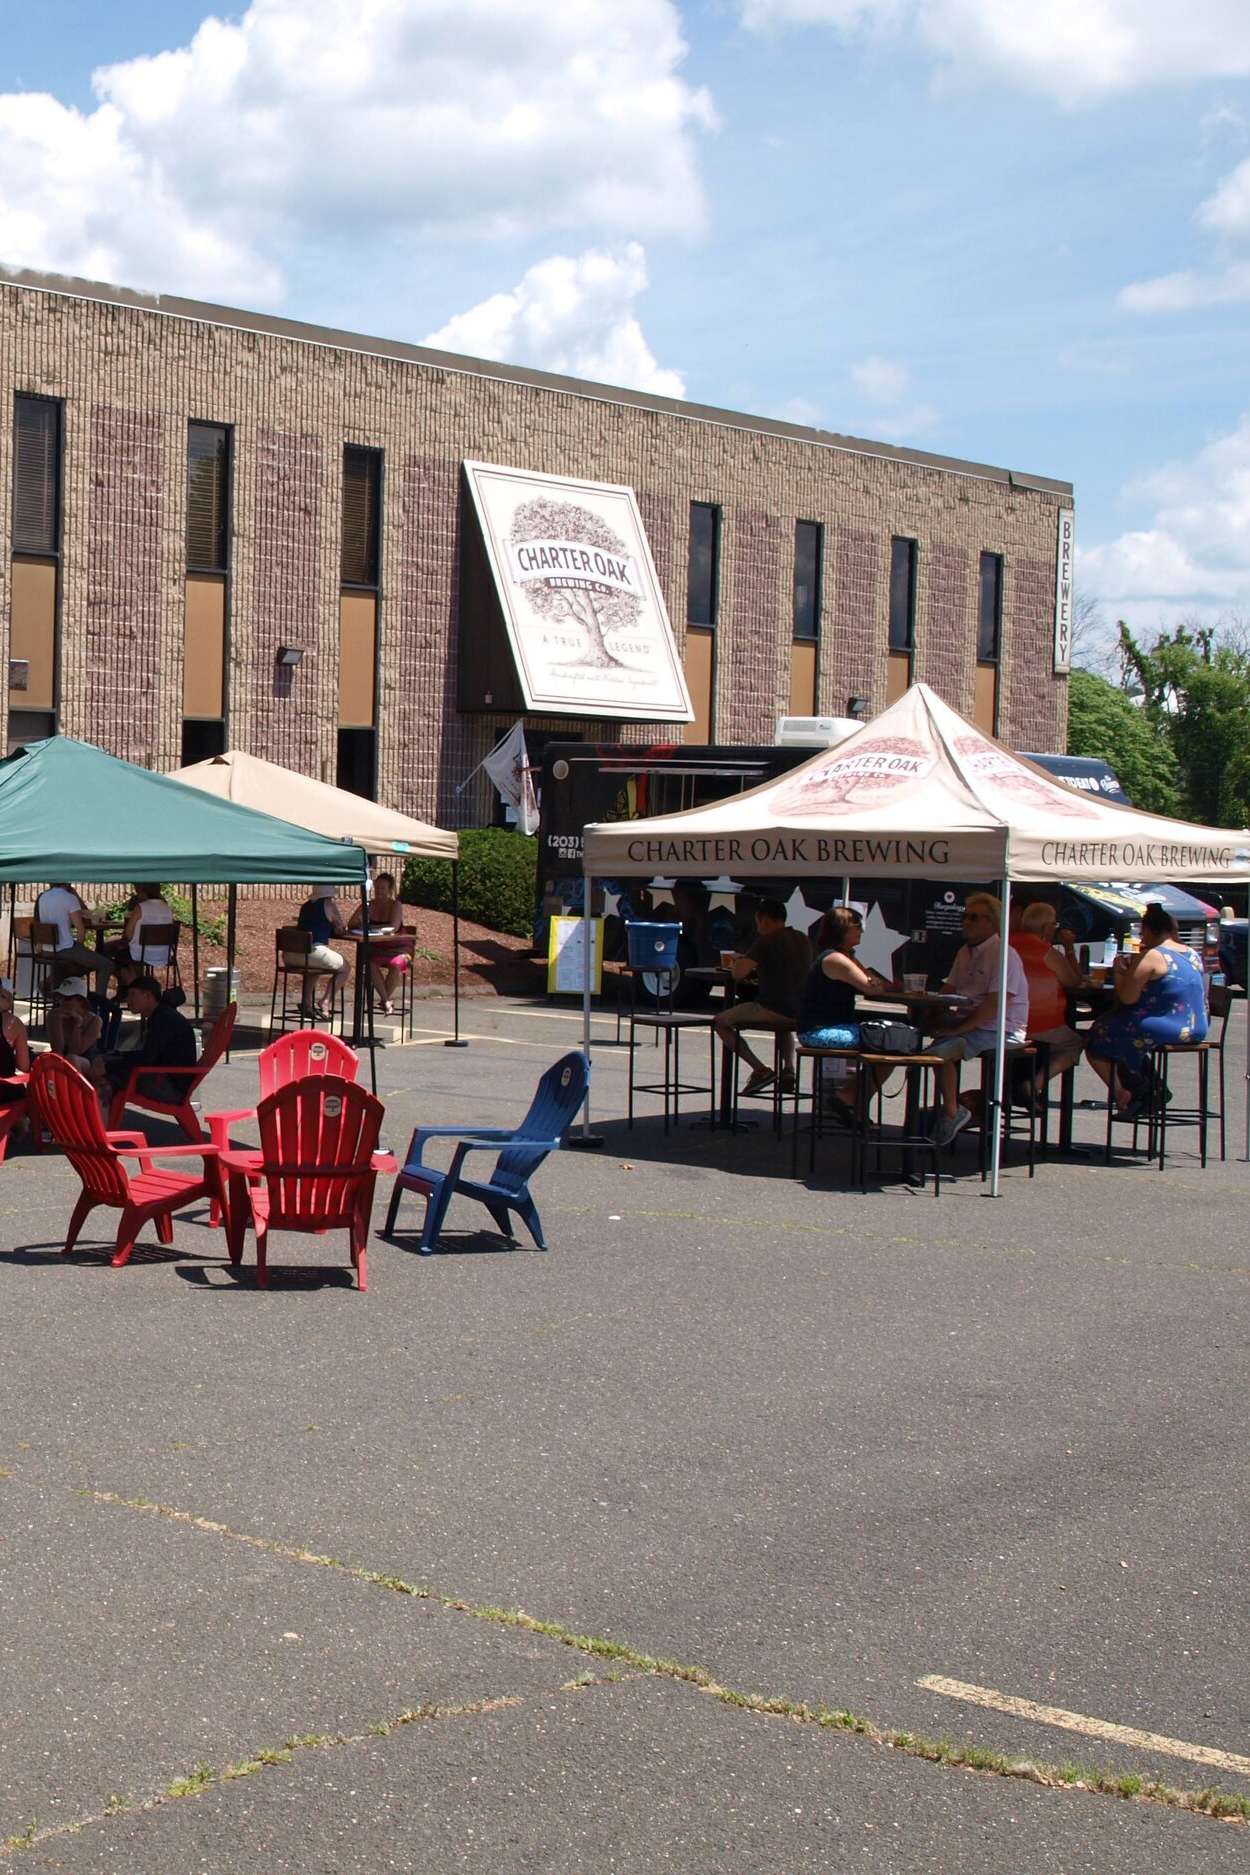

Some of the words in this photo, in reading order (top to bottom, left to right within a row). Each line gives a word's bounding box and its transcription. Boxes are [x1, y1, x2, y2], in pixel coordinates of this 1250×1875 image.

[517, 547, 594, 573] CHARTER
[594, 552, 632, 585] OAK
[549, 577, 593, 590] BREWING
[1059, 521, 1071, 662] BREWERY
[542, 635, 549, 644] A
[553, 636, 582, 648] TRUE
[609, 642, 649, 654] LEGEND
[888, 757, 924, 773] OAK
[547, 834, 579, 849] (203)
[627, 840, 744, 863] CHARTER
[751, 838, 811, 862] OAK
[816, 839, 950, 864] BREWING
[1041, 841, 1119, 867] CHARTER
[1122, 843, 1157, 867] OAK
[1160, 845, 1231, 868] BREWING
